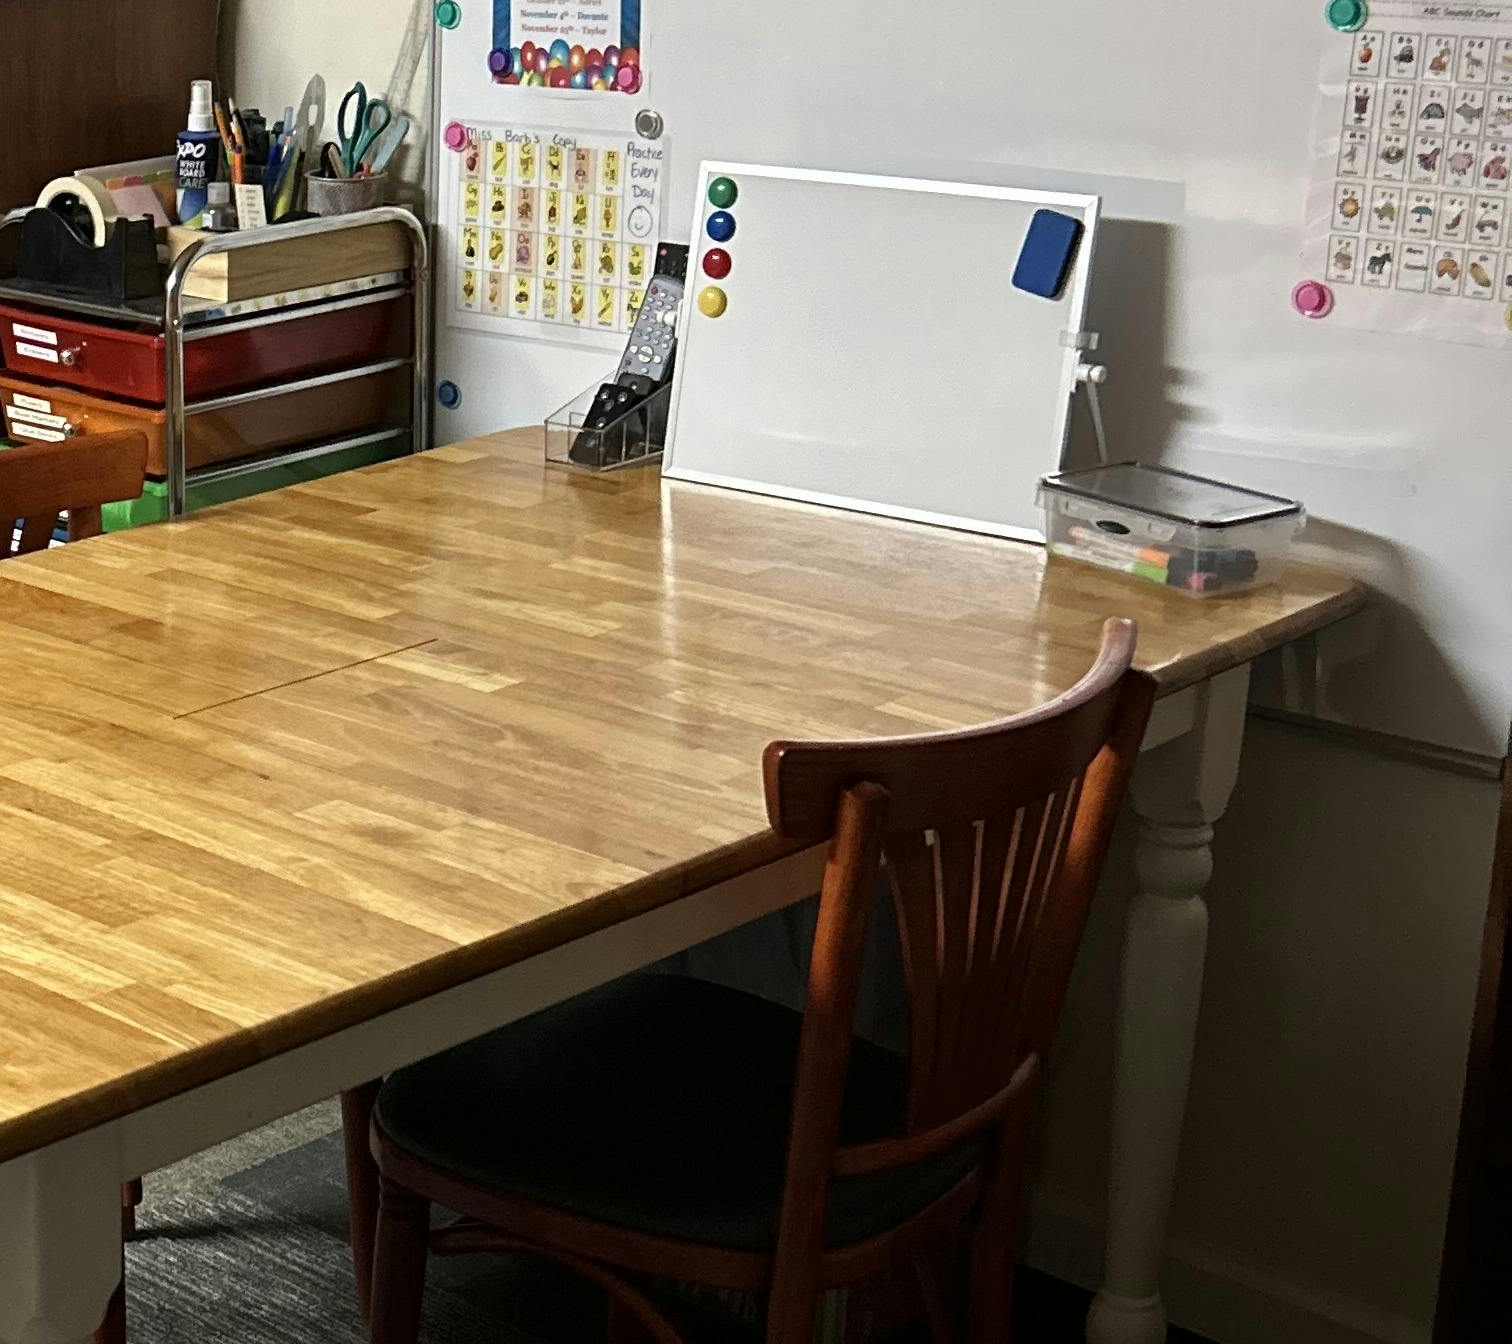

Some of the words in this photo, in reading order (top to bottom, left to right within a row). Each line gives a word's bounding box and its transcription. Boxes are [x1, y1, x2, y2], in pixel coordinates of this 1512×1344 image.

[520, 10, 558, 19] November
[521, 23, 559, 33] November
[467, 127, 492, 141] Miss
[505, 129, 540, 144] Barb's
[552, 133, 577, 152] Copy
[627, 141, 663, 160] Practice
[179, 160, 205, 168] WHITE
[179, 167, 206, 177] BOARD
[631, 162, 658, 183] Every
[179, 177, 206, 188] CARE
[632, 185, 655, 204] Day
